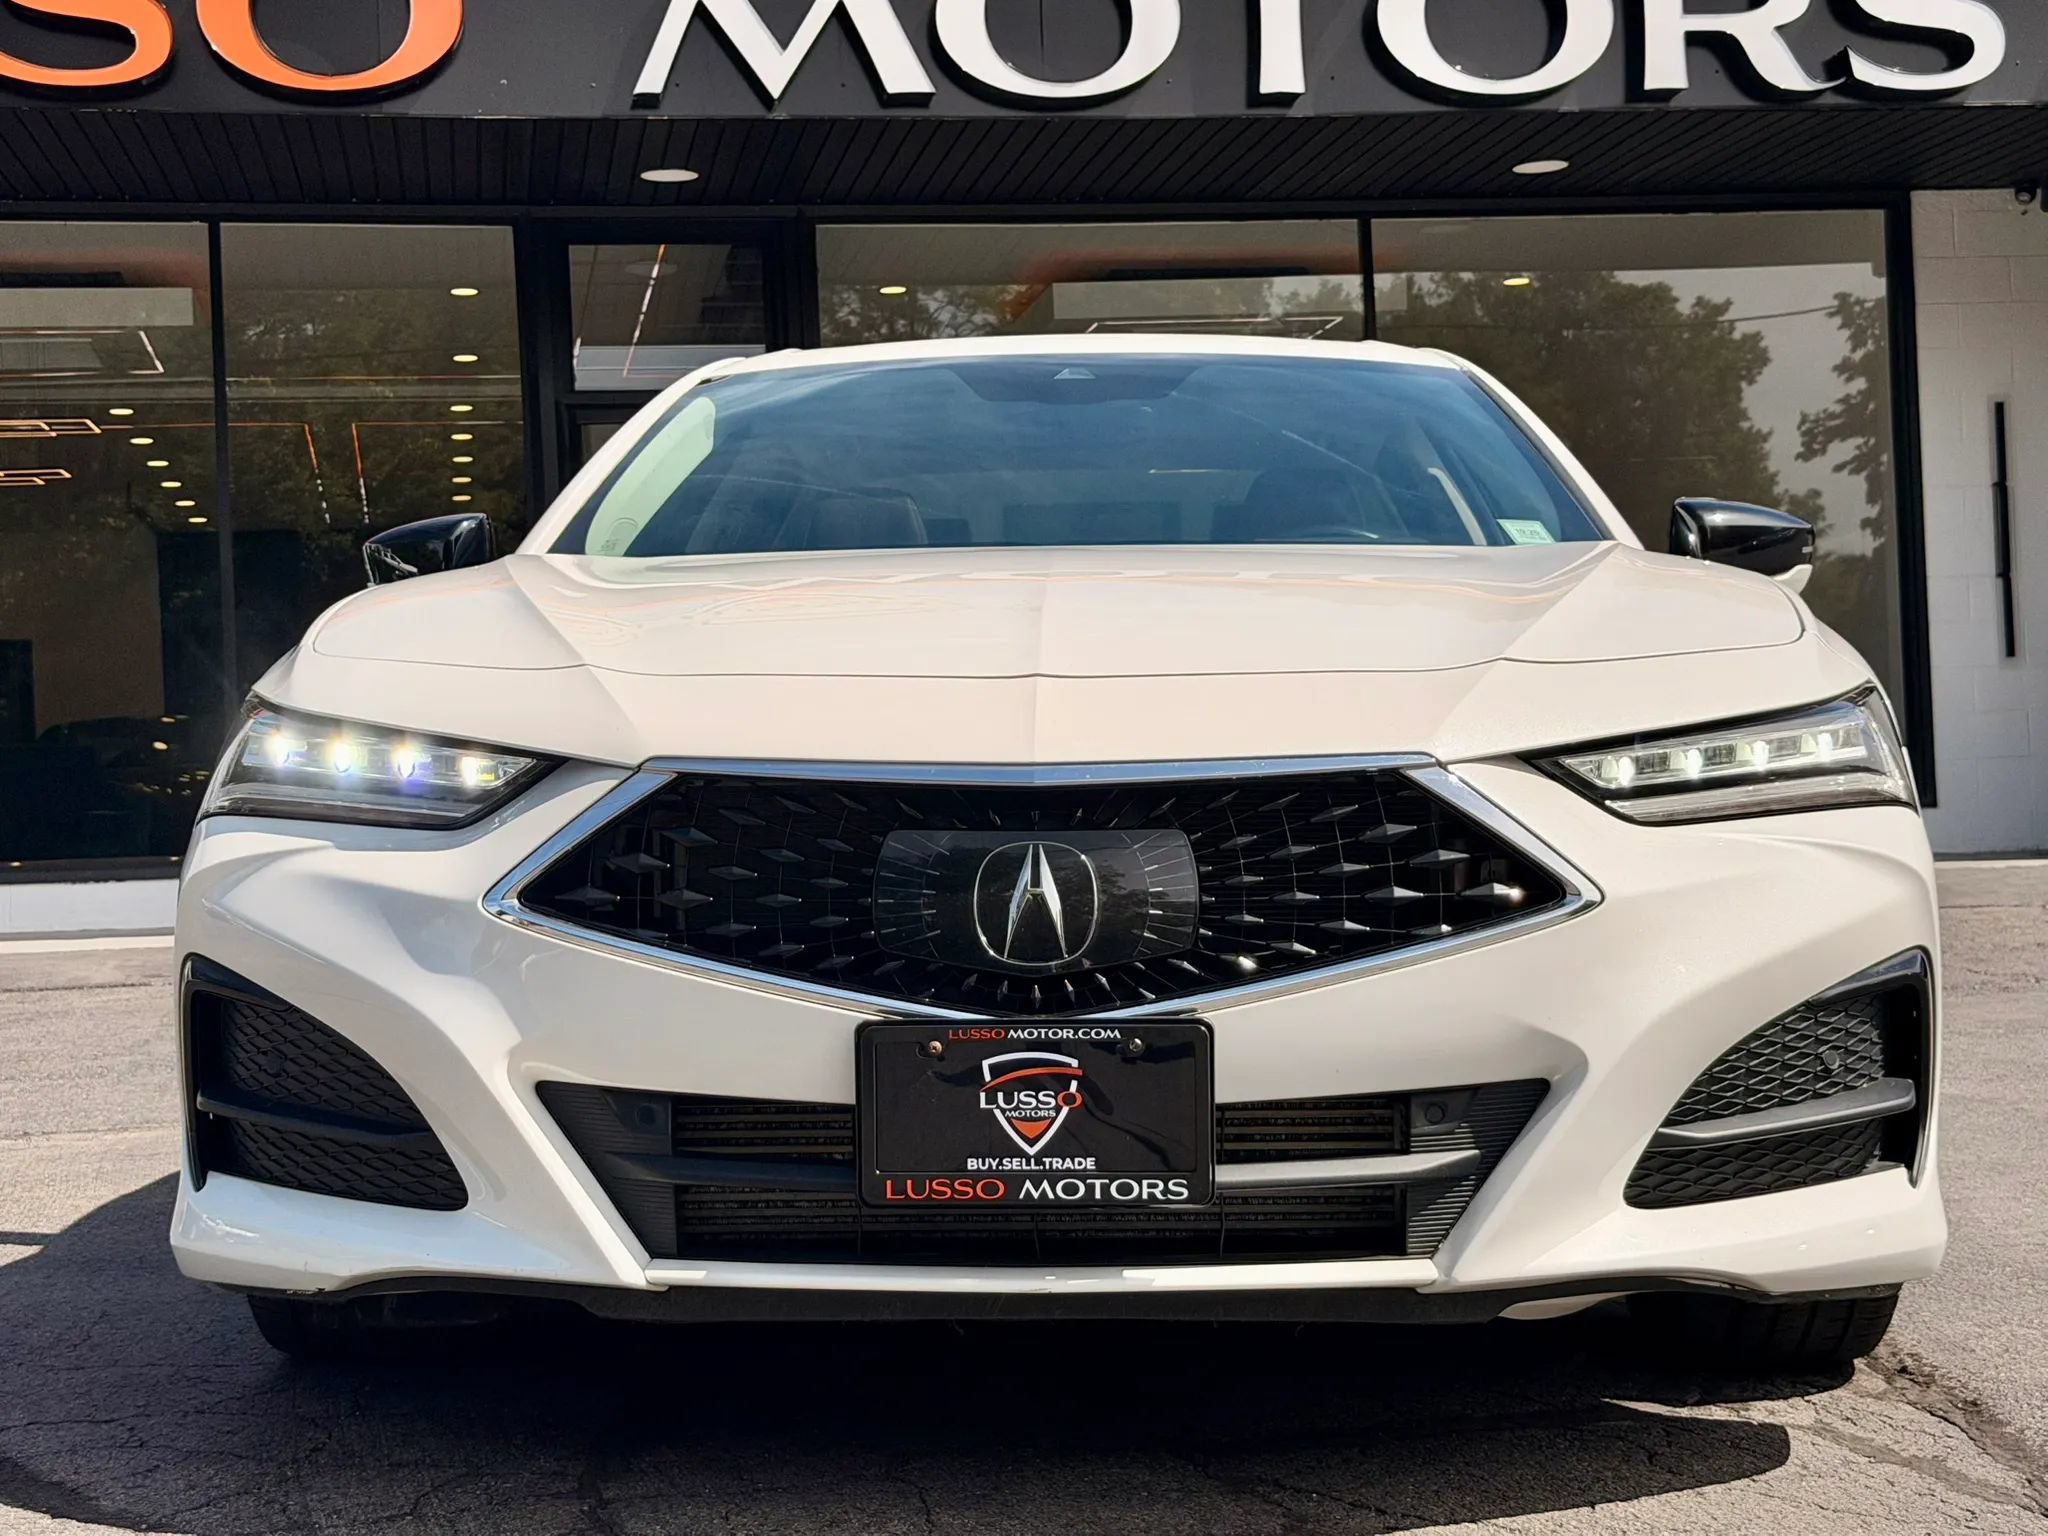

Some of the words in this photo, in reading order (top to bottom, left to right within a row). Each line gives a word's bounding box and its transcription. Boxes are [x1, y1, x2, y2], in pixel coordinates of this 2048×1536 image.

[980, 1091, 1082, 1108] LUSSO
[1005, 1109, 1057, 1118] MOTORS
[886, 1178, 1005, 1200] LUSSO
[1018, 1178, 1190, 1200] MOTORS
